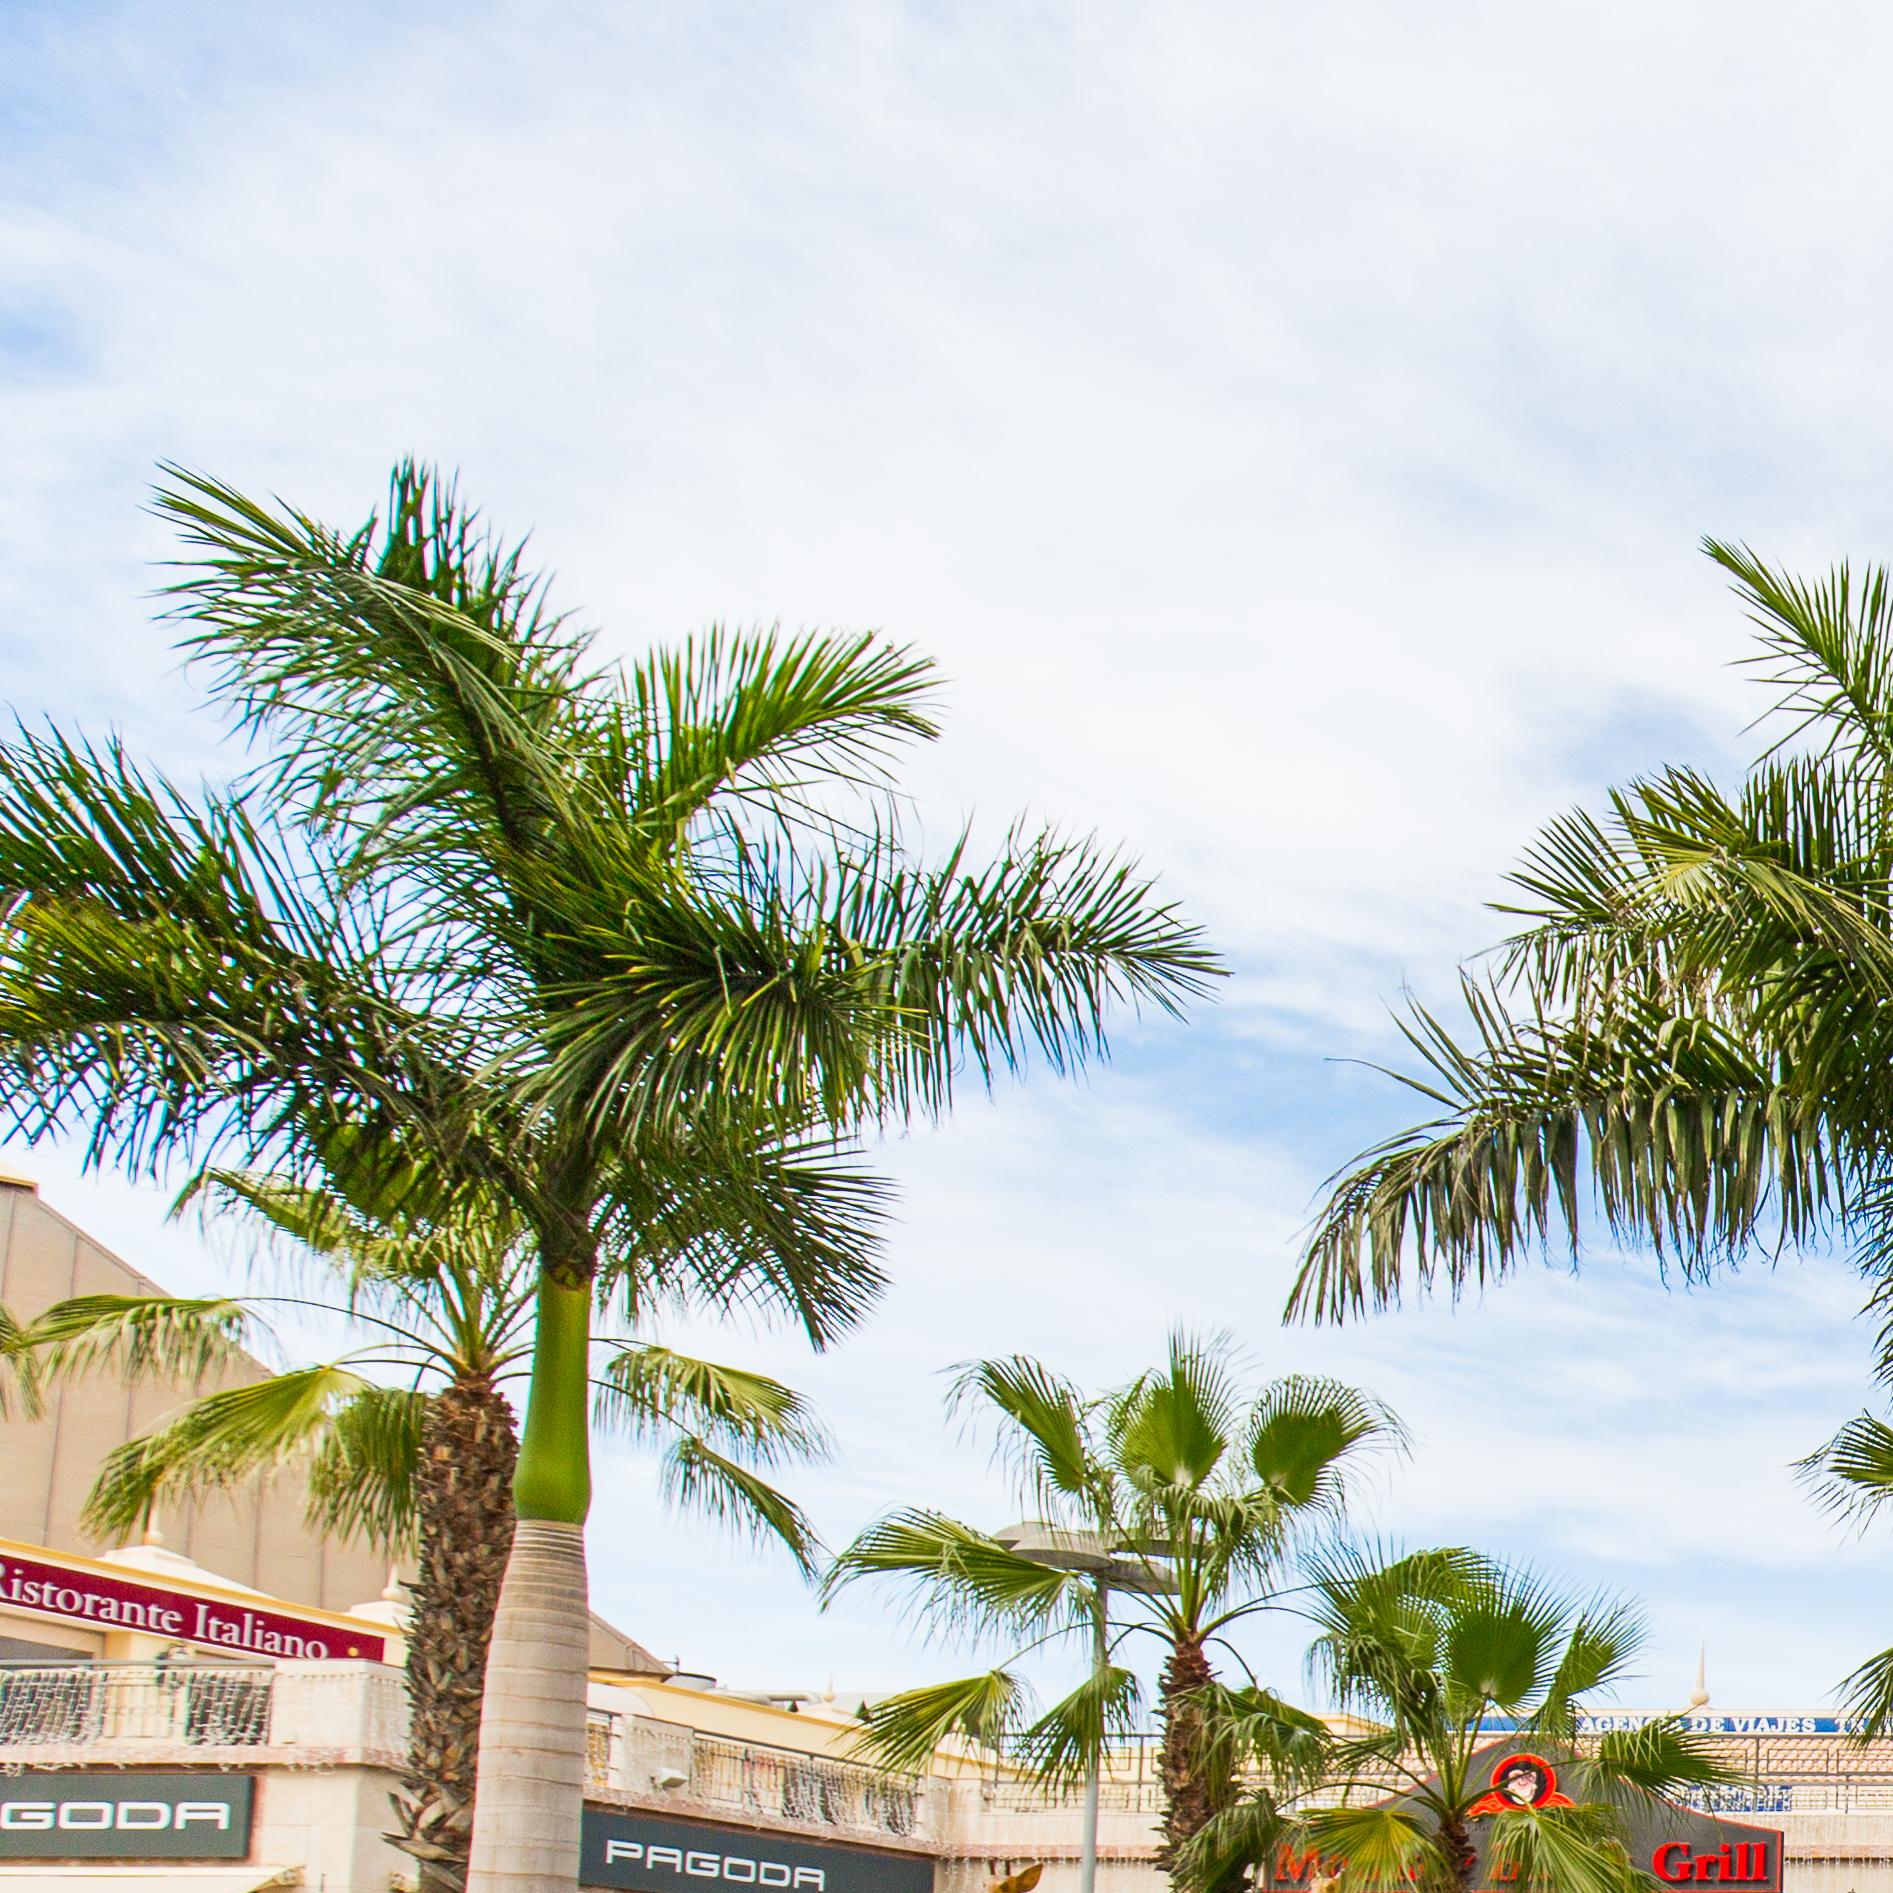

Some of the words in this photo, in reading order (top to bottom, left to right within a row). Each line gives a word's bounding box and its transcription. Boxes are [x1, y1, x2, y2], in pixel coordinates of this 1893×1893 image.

[193, 1602, 329, 1659] Italiano
[1691, 1717, 1725, 1732] DE
[1733, 1717, 1816, 1733] VIAJES
[605, 1839, 825, 1892] PAGODA
[1652, 1840, 1769, 1883] Grill
